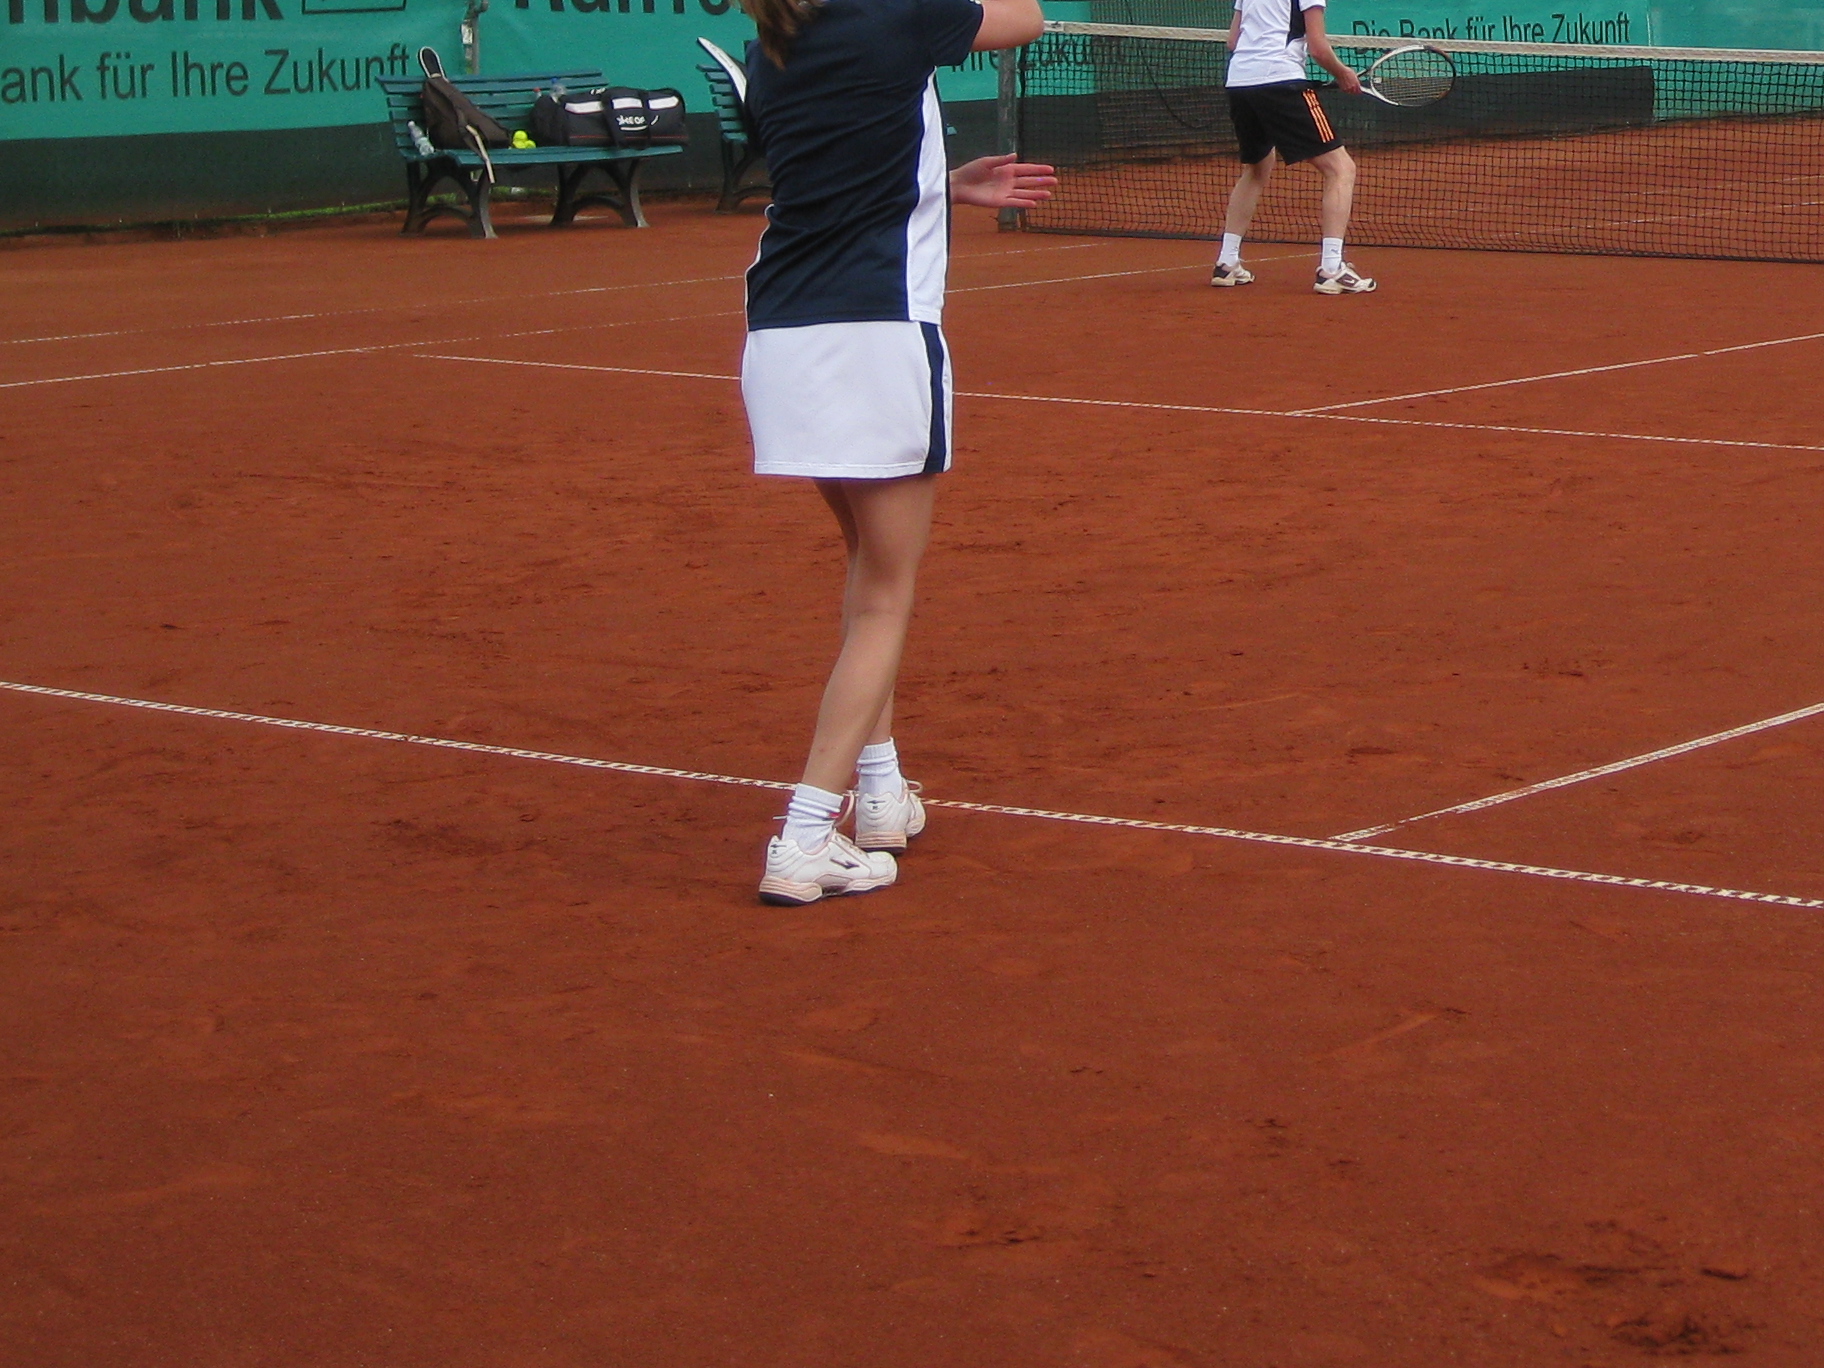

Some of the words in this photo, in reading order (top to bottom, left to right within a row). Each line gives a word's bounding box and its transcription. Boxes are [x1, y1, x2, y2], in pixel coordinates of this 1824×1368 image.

[1503, 15, 1545, 44] Ihre
[1551, 11, 1630, 45] Zukunft
[96, 52, 154, 101] für
[171, 50, 249, 98] Ihre
[263, 43, 409, 95] Zukunft
